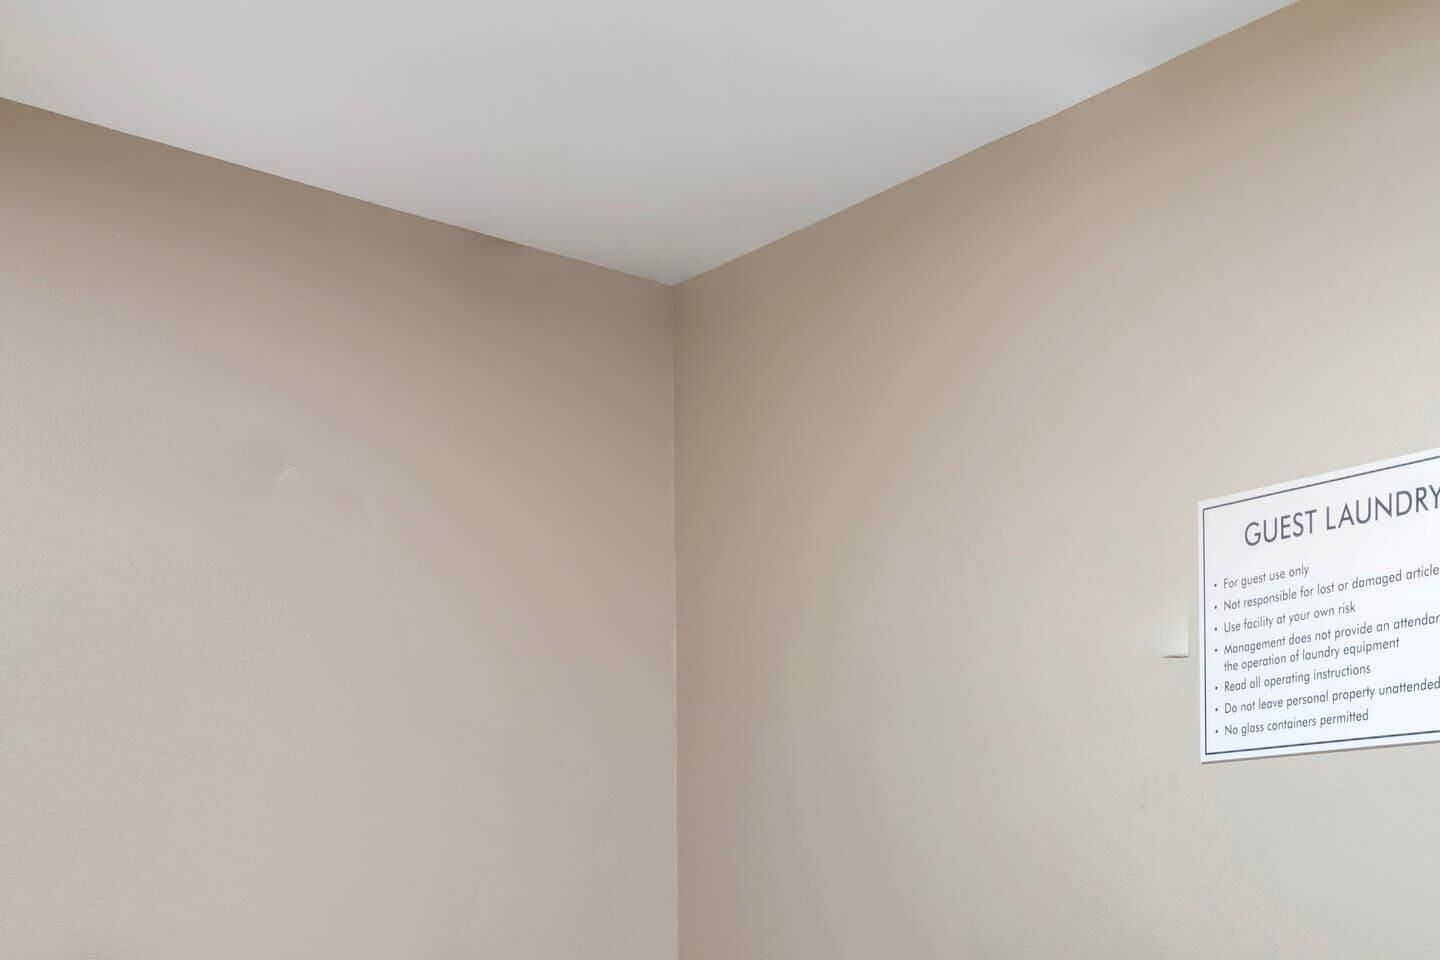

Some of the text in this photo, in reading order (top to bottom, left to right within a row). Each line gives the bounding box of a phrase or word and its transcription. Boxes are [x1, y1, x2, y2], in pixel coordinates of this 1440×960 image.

[1244, 509, 1317, 546] GUEST
[1223, 562, 1311, 591] For guest use only
[1223, 598, 1241, 612] Not
[1243, 587, 1297, 609] responsible
[1299, 584, 1315, 598] for
[1316, 581, 1335, 595] lost
[1337, 581, 1349, 592] or
[1351, 568, 1402, 591] damaged
[1223, 600, 1356, 633] Use facility at your own risk
[1223, 637, 1286, 655] Management
[1288, 631, 1312, 648] does
[1314, 628, 1331, 641] not
[1334, 621, 1373, 642] provide
[1375, 622, 1390, 633] an
[1223, 637, 1400, 672] the operation of laundry equipment
[1224, 663, 1372, 692] Read all operating instructions
[1224, 675, 1440, 714] Do not leave personal property unattended
[1224, 708, 1369, 737] No glass containers permitted
